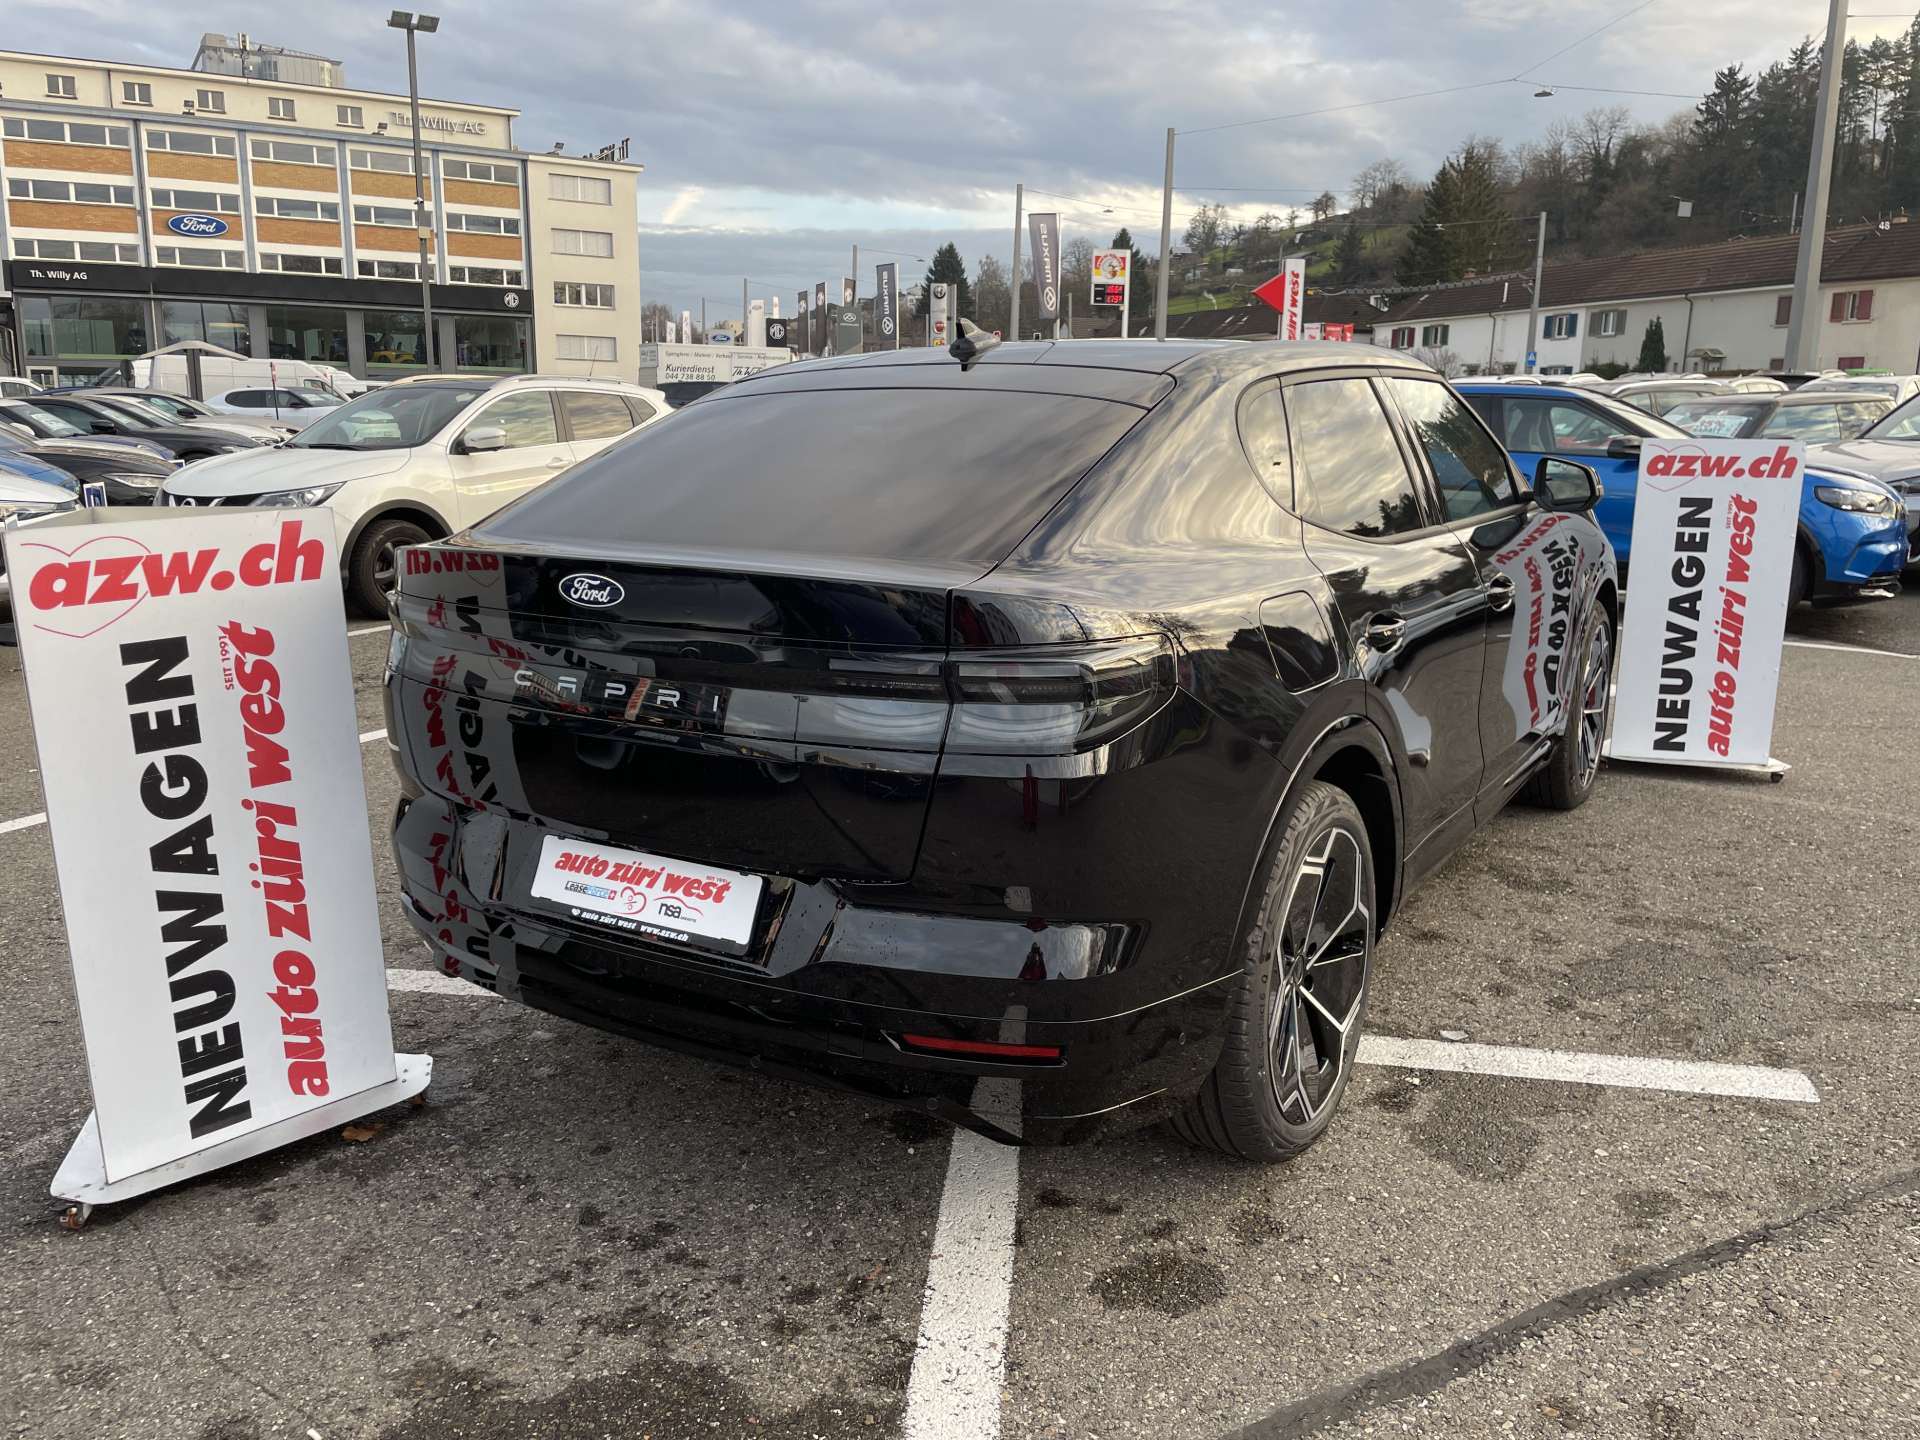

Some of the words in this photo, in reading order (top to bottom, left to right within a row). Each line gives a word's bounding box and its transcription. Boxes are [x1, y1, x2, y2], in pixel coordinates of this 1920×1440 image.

[421, 113, 458, 133] Willy
[463, 118, 487, 135] AG
[180, 216, 217, 233] Ford
[1879, 221, 1890, 230] 48
[29, 269, 46, 278] Th.
[46, 270, 71, 281] Willy
[72, 271, 88, 280] AG
[770, 323, 784, 339] MG
[665, 363, 715, 374] Kurierdienst
[1646, 446, 1798, 479] azw.ch
[1726, 494, 1758, 583] west
[29, 520, 325, 611] azw.ch
[570, 577, 612, 604] Ford
[1653, 497, 1714, 752] NEUWAGEN
[1714, 586, 1747, 672] züri
[219, 634, 231, 662] 1991
[224, 667, 235, 691] SEIT
[217, 619, 293, 789] west
[1707, 671, 1737, 757] auto
[241, 798, 312, 943] züri
[555, 852, 609, 878] auto
[605, 861, 666, 889] züri
[662, 873, 732, 904] west
[119, 635, 253, 1140] NEUWAGEN
[658, 902, 682, 919] nsa
[266, 949, 331, 1098] auto
